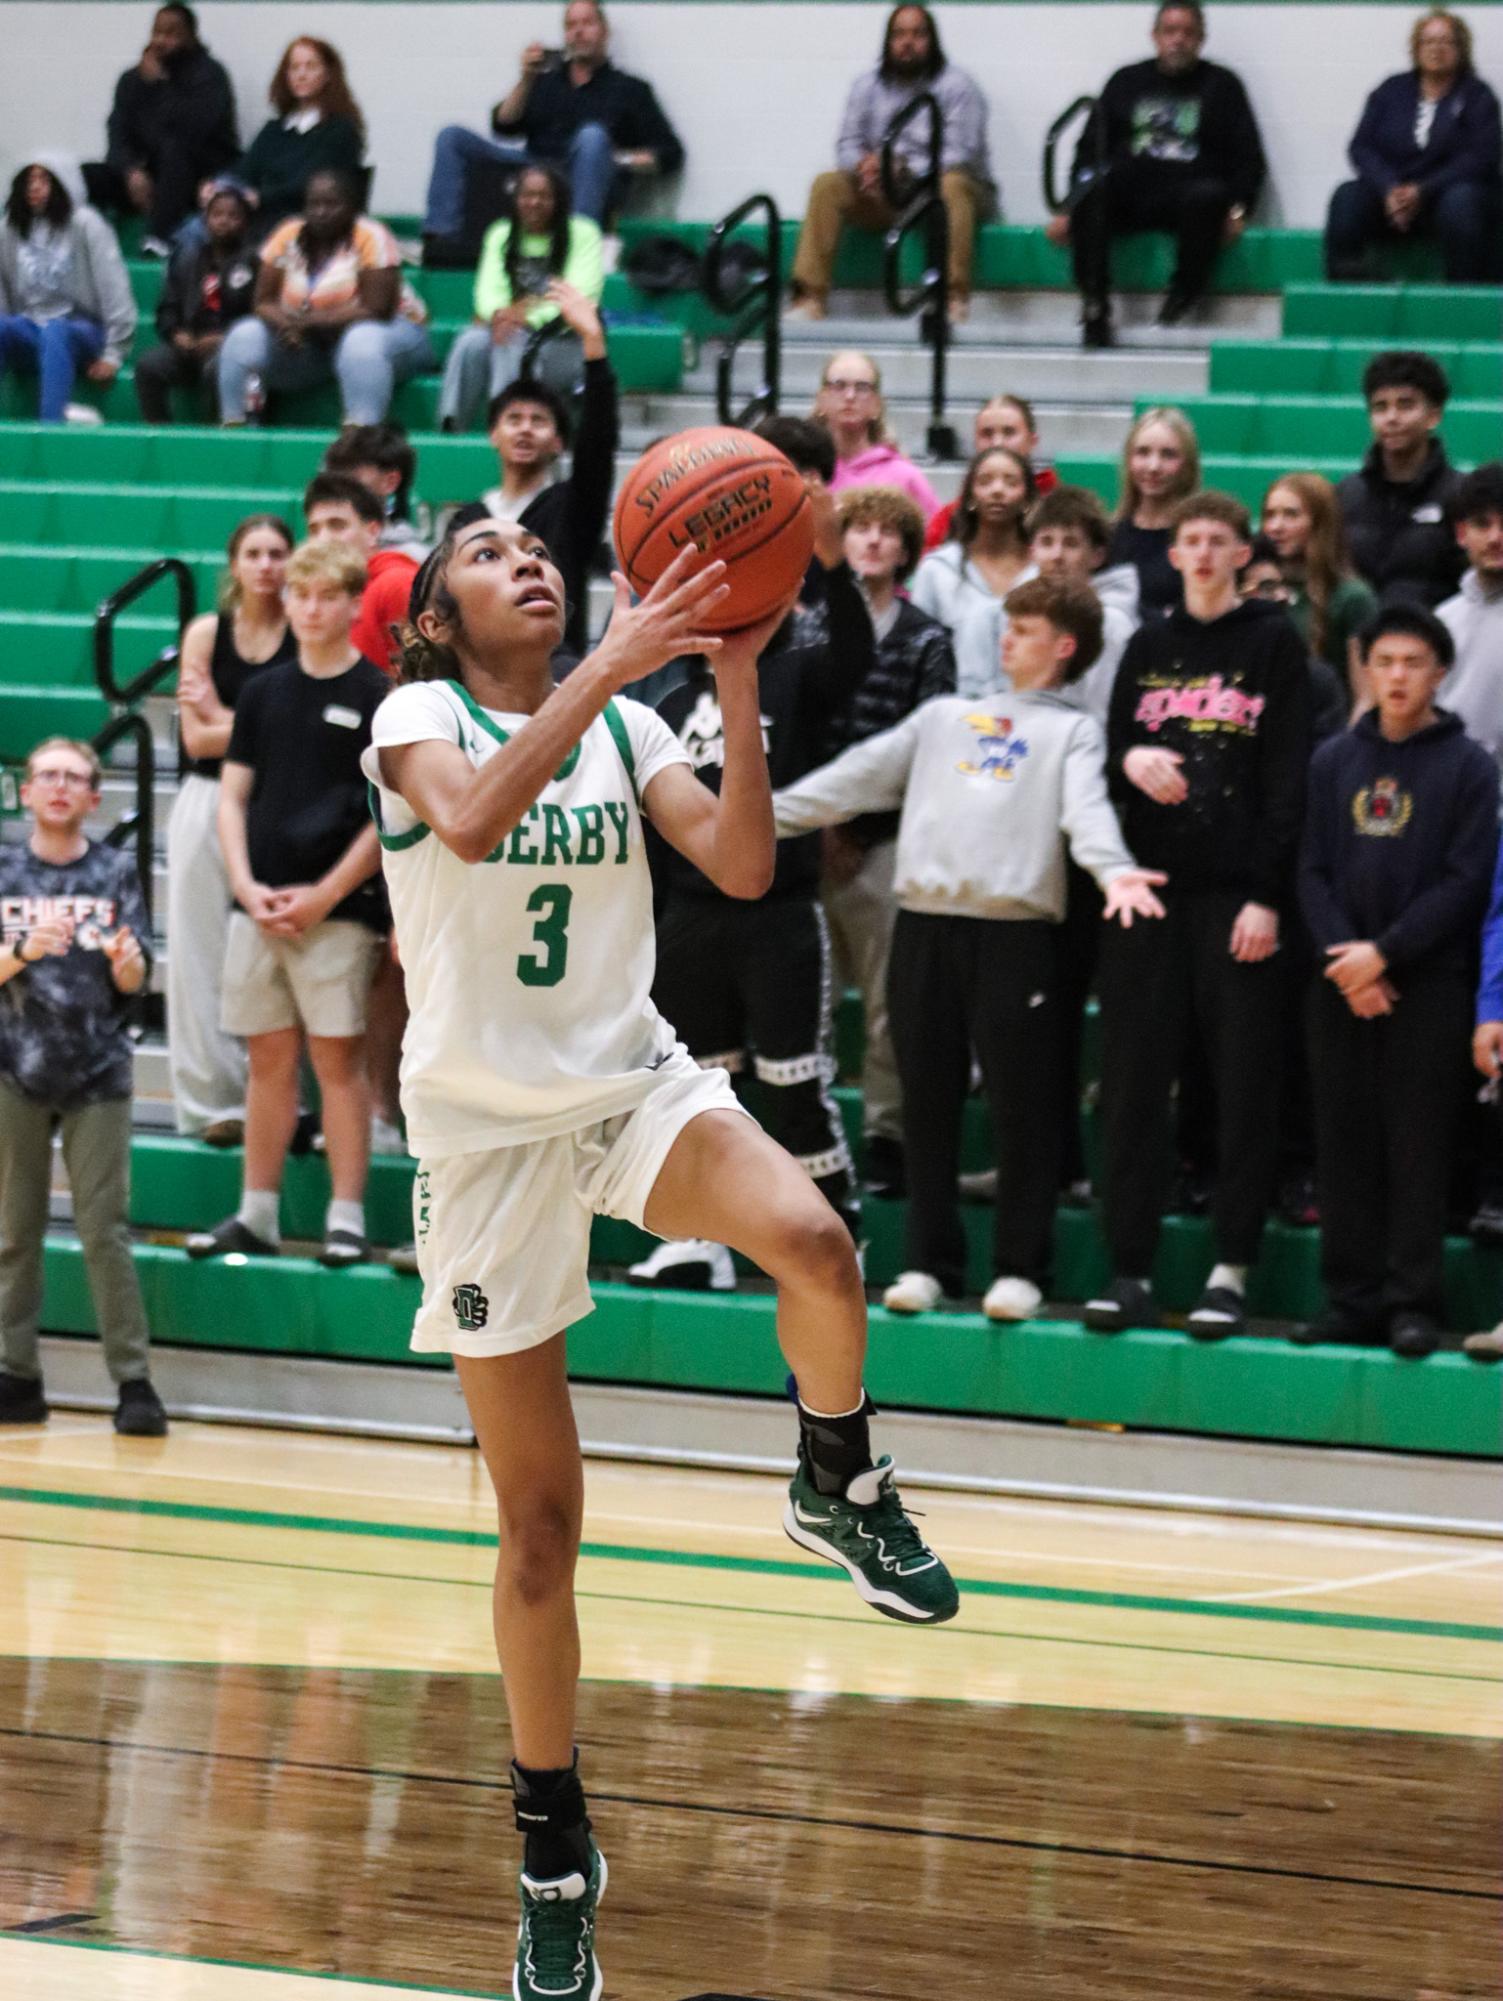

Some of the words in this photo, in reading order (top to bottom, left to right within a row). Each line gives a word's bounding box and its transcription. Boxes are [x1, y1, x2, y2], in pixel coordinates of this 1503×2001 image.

[668, 475, 770, 548] LEGACY
[482, 801, 629, 865] ERBY
[1, 895, 116, 927] CHIEFS
[516, 883, 573, 987] 3
